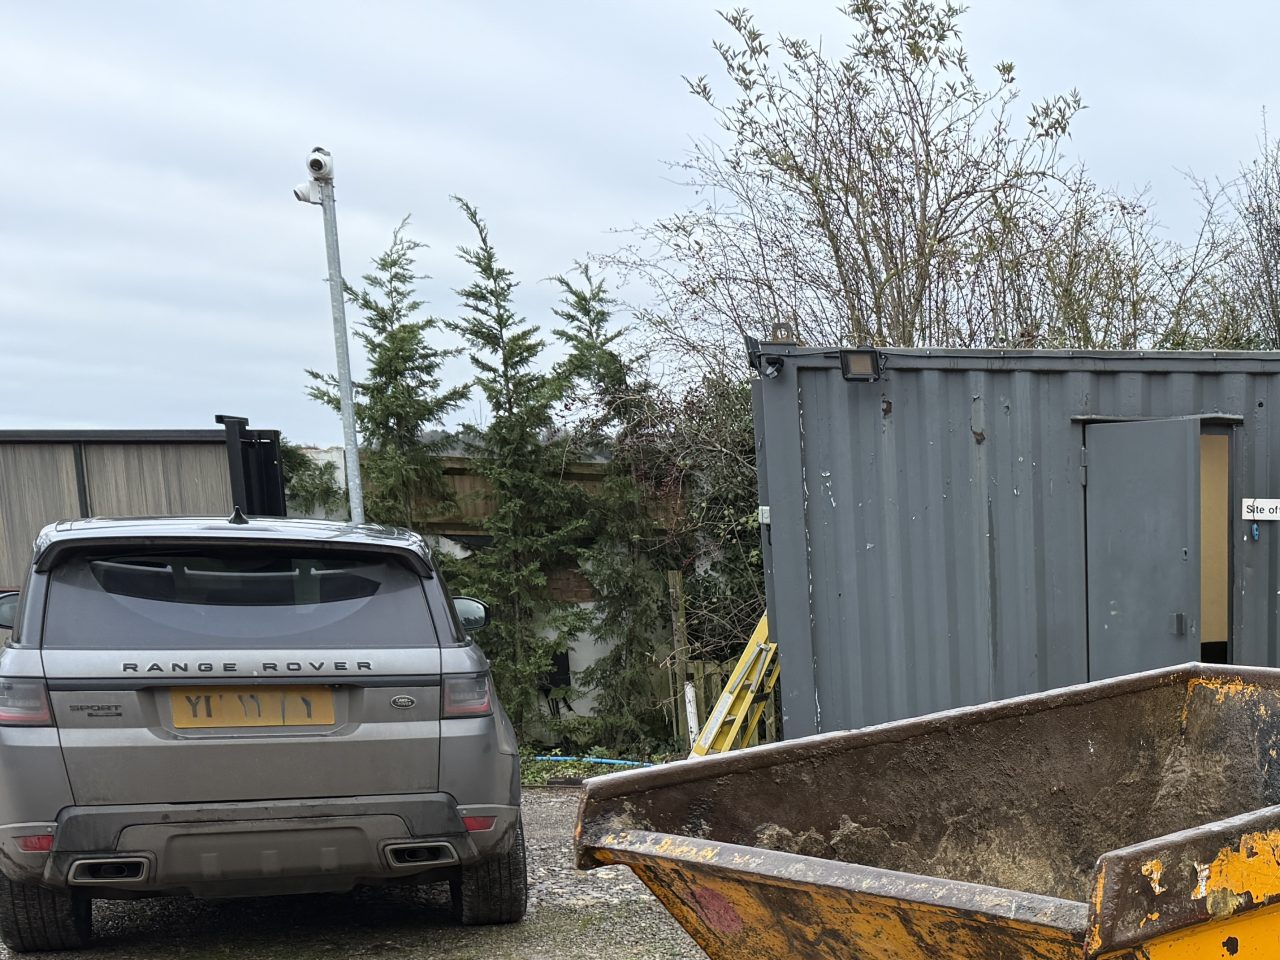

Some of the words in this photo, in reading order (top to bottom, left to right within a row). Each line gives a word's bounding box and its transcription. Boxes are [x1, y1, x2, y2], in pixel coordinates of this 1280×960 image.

[1246, 504, 1265, 514] Site
[122, 662, 237, 672] RANGE
[262, 661, 372, 672] ROVER
[69, 704, 122, 712] SPORT
